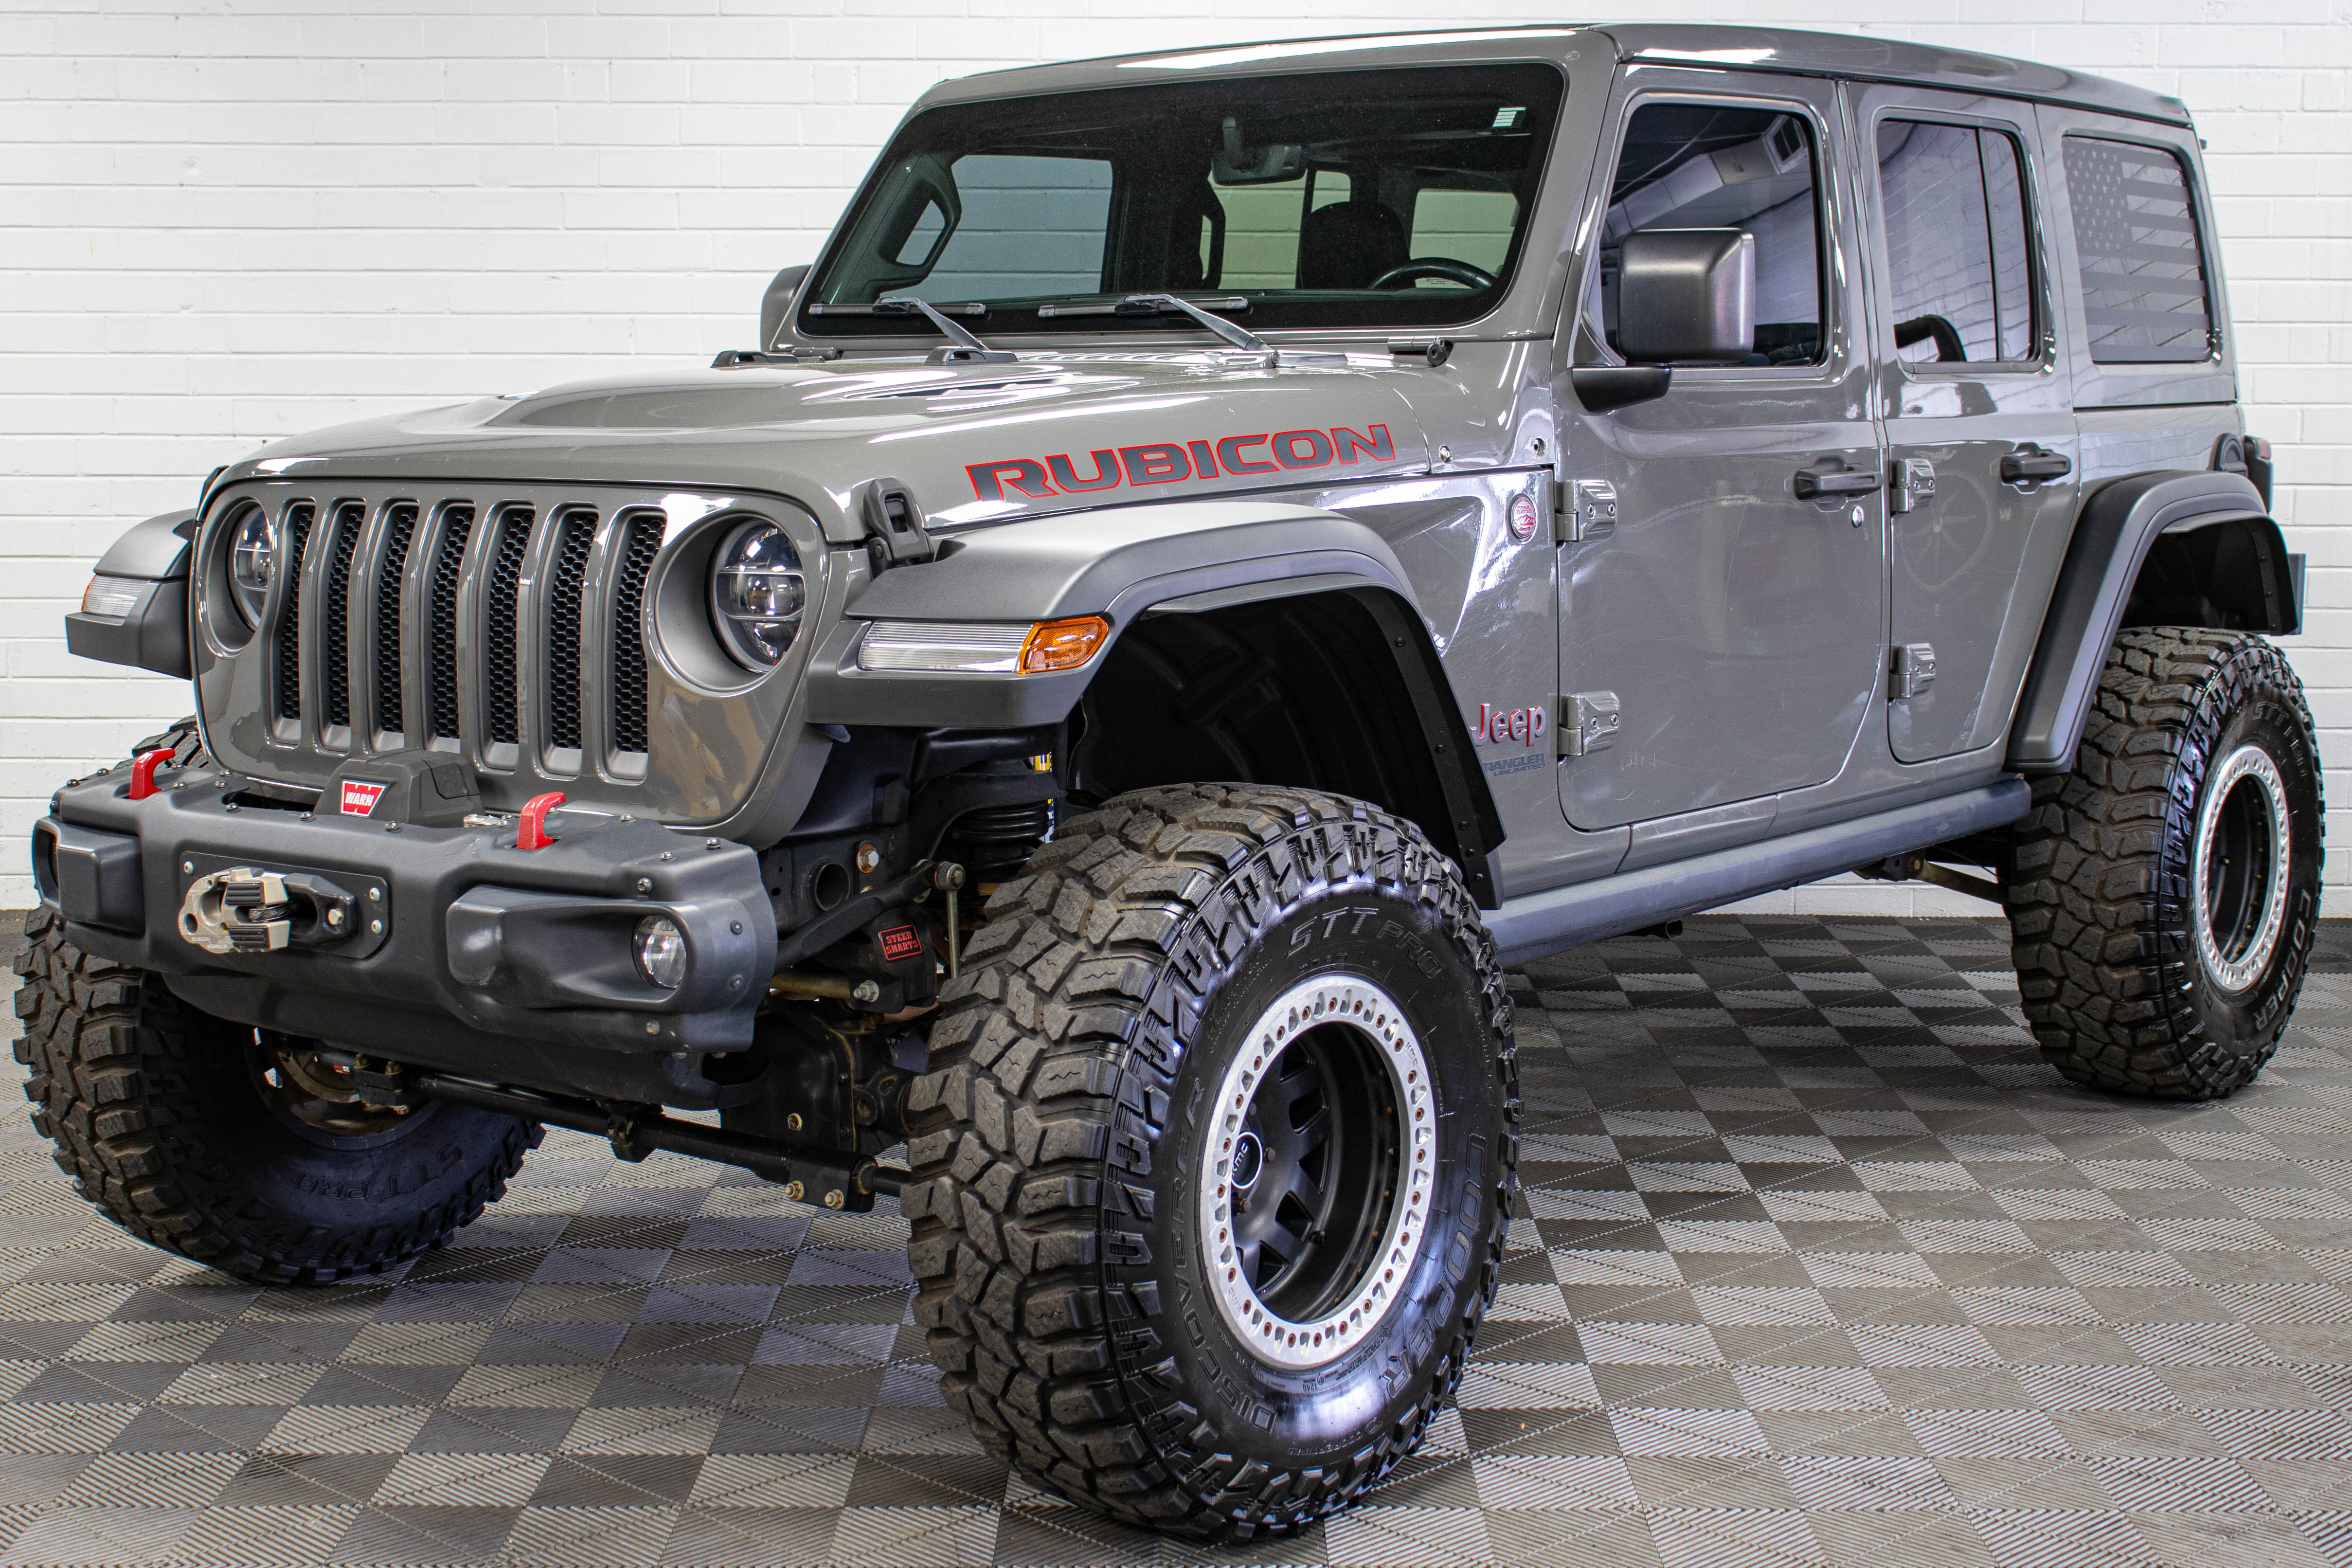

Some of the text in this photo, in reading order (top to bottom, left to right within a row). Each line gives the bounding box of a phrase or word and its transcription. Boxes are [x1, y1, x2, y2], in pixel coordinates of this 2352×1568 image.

[965, 424, 1396, 502] RUBICON
[1469, 703, 1546, 747] Jeep
[1483, 753, 1545, 772] RANGLER
[1493, 763, 1545, 776] UNLIMITED
[345, 792, 375, 807] WARN
[885, 931, 913, 944] STEER
[885, 939, 918, 955] SMARTS
[1286, 906, 1442, 979] STT PRO
[2255, 888, 2311, 1031] COOPER
[1172, 1077, 1278, 1434] DISCOVERER
[1380, 1133, 1488, 1399] COOPER
